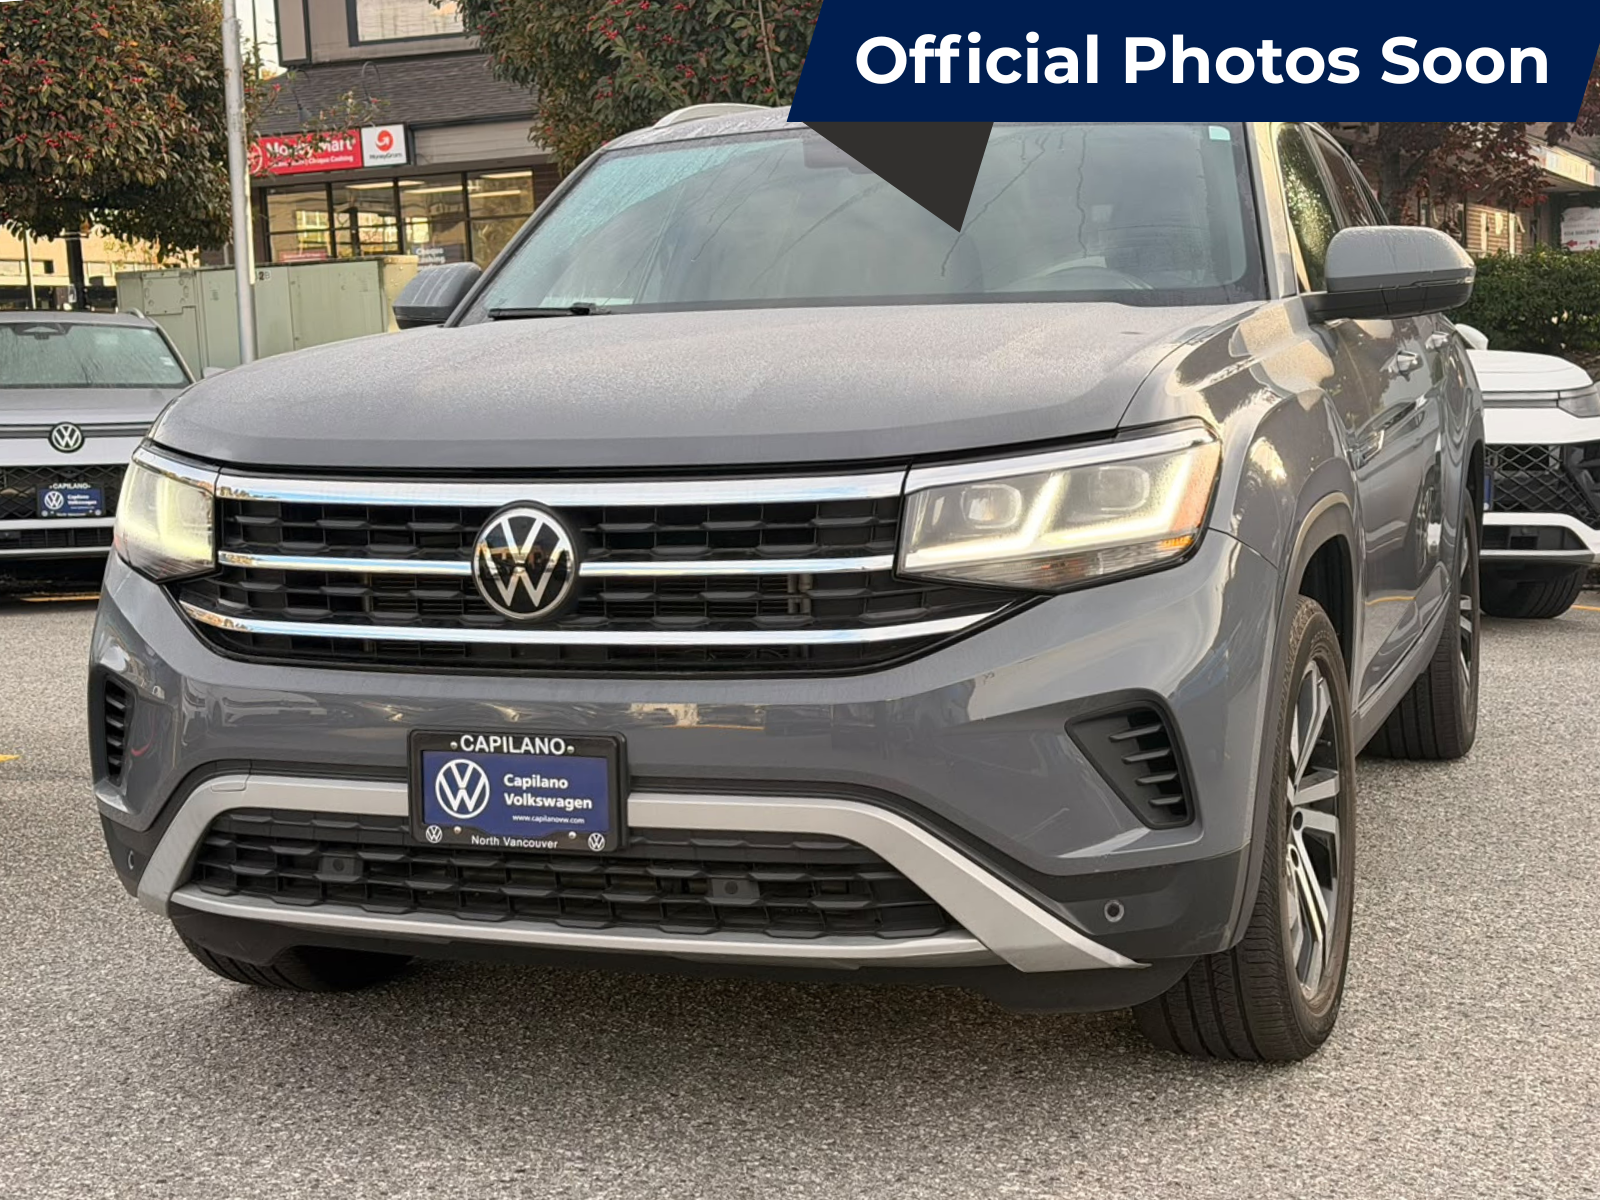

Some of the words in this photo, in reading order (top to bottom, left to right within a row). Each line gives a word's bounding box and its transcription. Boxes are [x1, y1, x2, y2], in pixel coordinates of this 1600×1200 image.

[460, 735, 566, 755] CAPILANO
[504, 773, 569, 790] Capilano
[504, 793, 593, 811] Volkswagen
[512, 815, 585, 824] www.capilanovw.com
[471, 835, 500, 846] North
[503, 837, 558, 849] Vancouver
